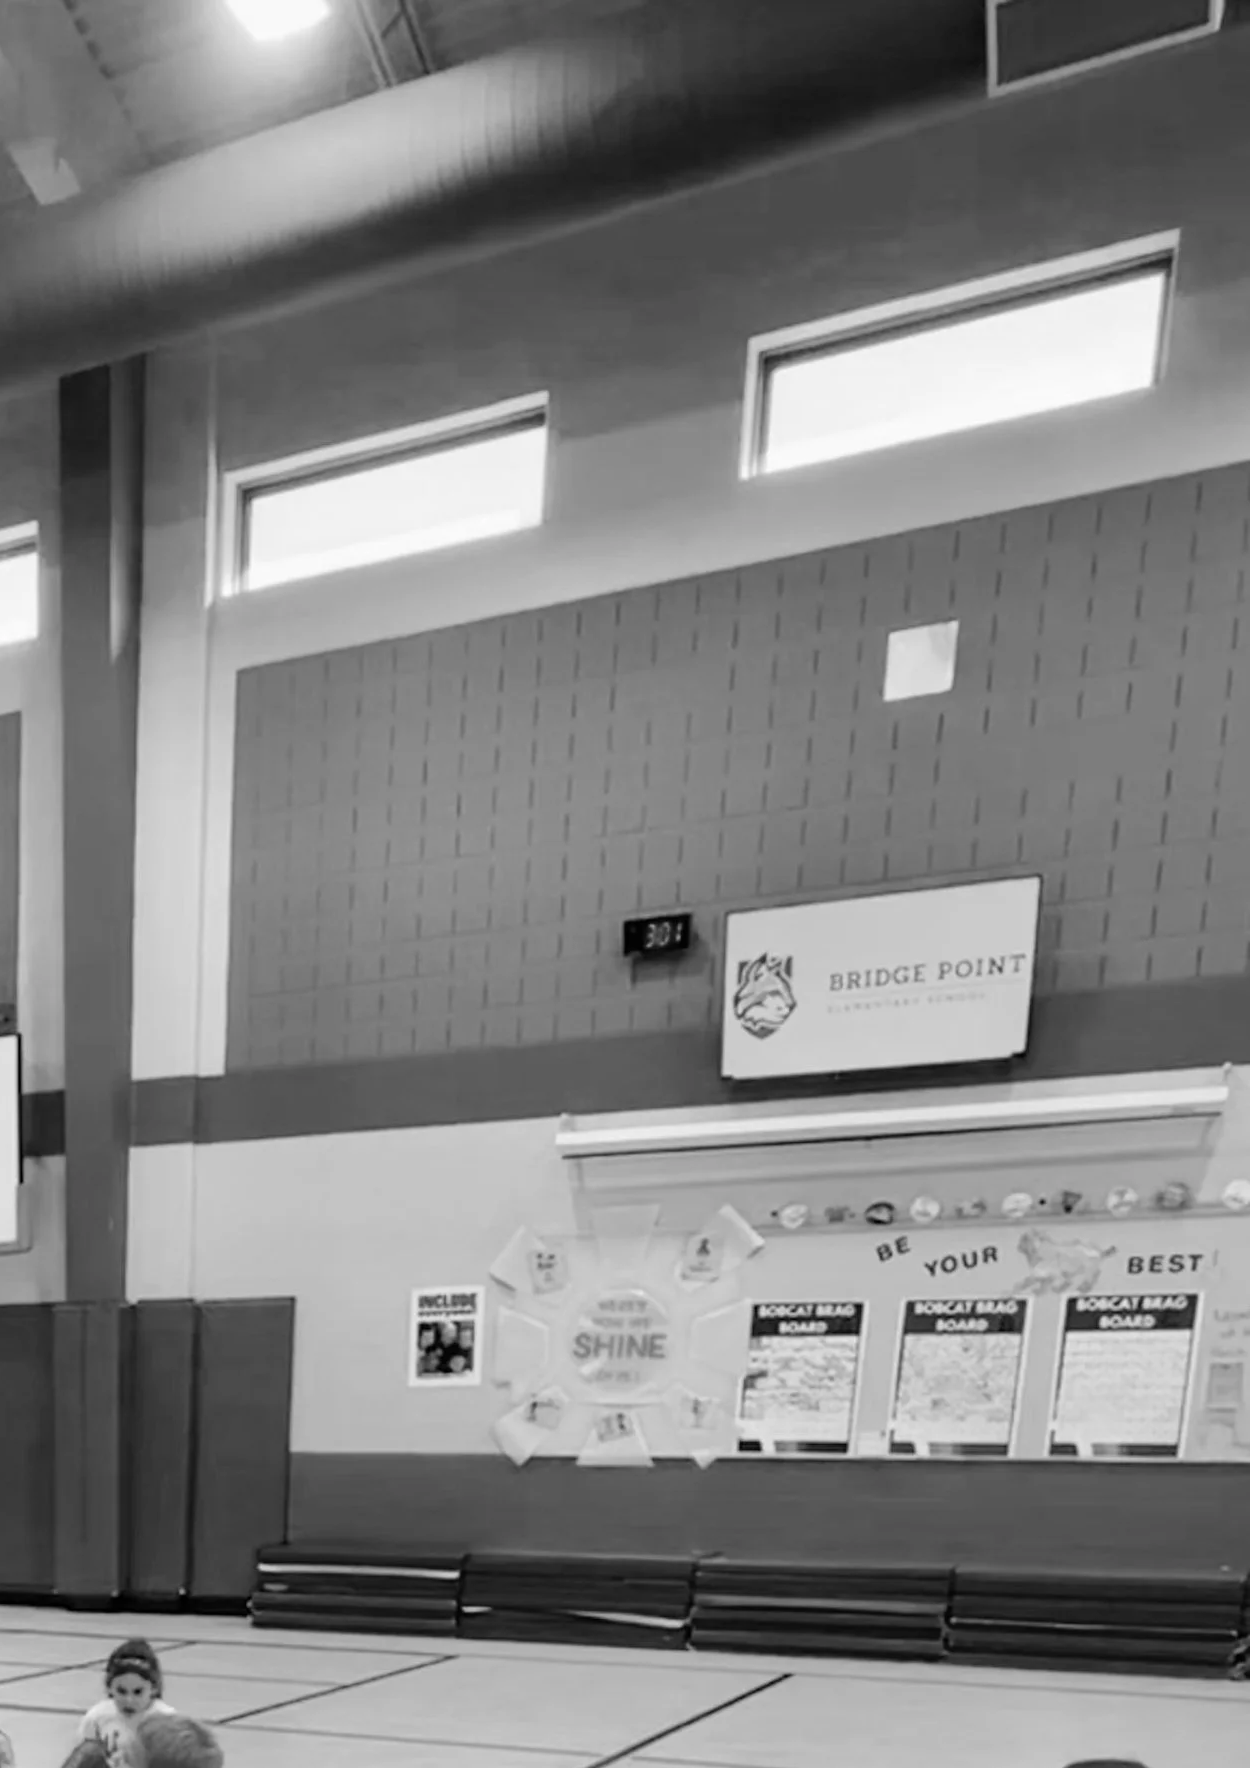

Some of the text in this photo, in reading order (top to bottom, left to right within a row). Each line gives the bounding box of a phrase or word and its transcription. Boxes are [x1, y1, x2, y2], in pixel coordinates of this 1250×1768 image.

[829, 953, 1027, 992] BRIDGE POINT
[876, 1235, 910, 1262] BE
[924, 1246, 998, 1277] YOUR
[418, 1293, 478, 1310] INCLUDE
[914, 1300, 1019, 1316] BOBCAT BRAG
[1076, 1296, 1189, 1312] BOBCAT BRAG
[758, 1303, 855, 1318] BOBCAT BRAG
[778, 1321, 828, 1334] BOARD
[935, 1318, 989, 1332] BOARD
[1099, 1314, 1156, 1328] BOARD
[573, 1332, 668, 1360] SHINE
